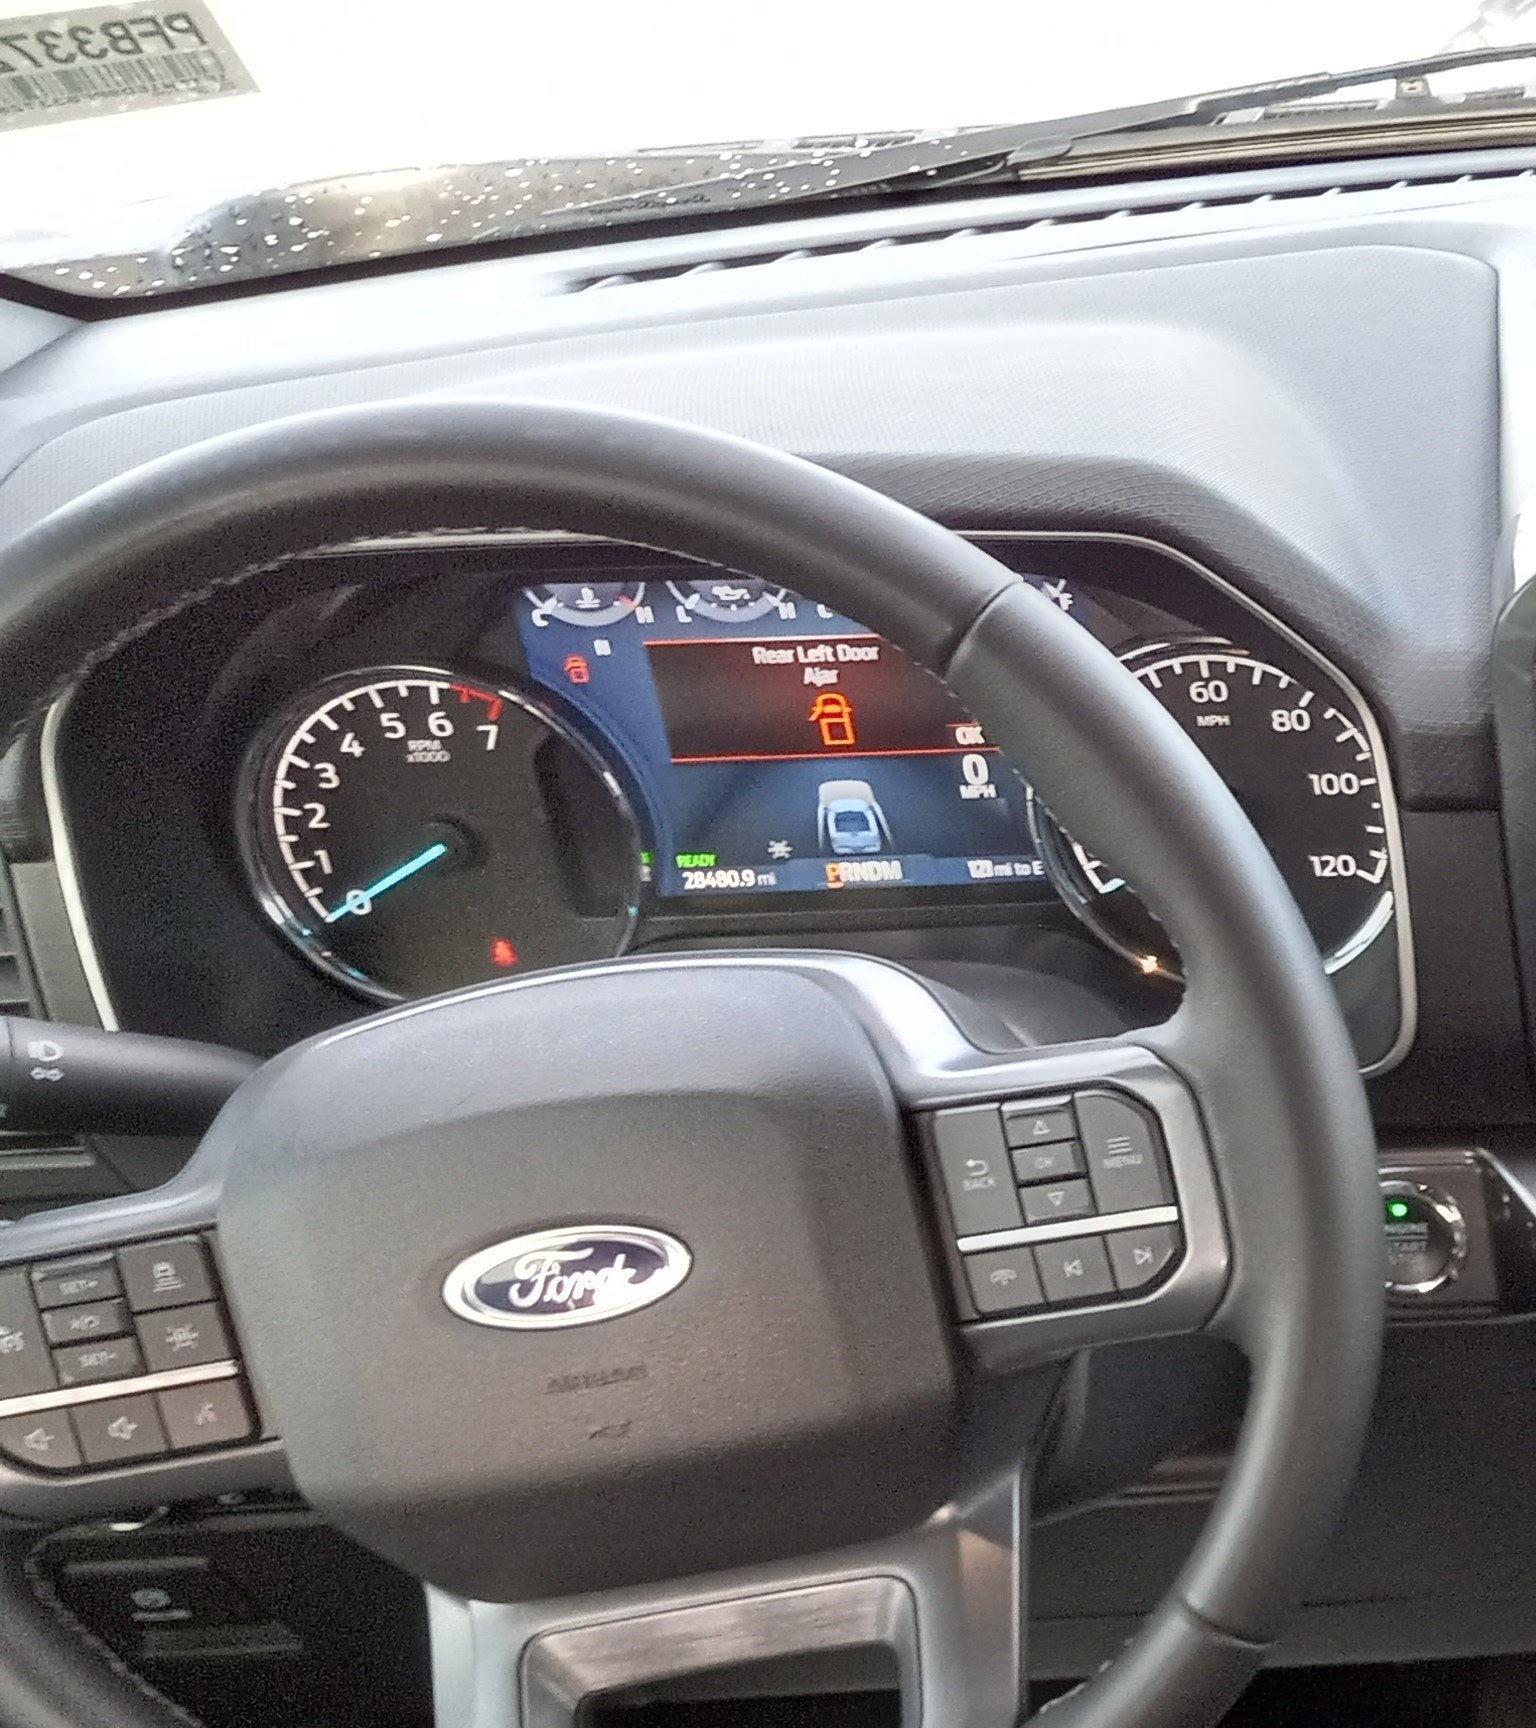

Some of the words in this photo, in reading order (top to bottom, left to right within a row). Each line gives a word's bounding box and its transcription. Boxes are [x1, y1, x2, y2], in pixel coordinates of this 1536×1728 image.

[636, 605, 655, 624] H
[779, 601, 797, 620] H
[753, 646, 795, 665] Rear
[799, 645, 834, 663] Left
[837, 644, 879, 662] Door
[803, 667, 838, 686] Ajar
[1189, 680, 1229, 704] 60
[380, 712, 407, 740] 5
[428, 711, 454, 738] 6
[1196, 714, 1231, 728] MPH
[1271, 708, 1312, 733] 80
[340, 732, 365, 758] 4
[407, 738, 443, 752] RPM
[476, 723, 499, 751] 7
[955, 726, 985, 745] OK
[406, 751, 451, 763] x1000
[315, 763, 342, 789] 3
[961, 753, 989, 785] 0
[958, 783, 997, 799] MPH
[1308, 773, 1361, 796] 100
[302, 803, 331, 829] 2
[314, 848, 334, 875] 1
[676, 853, 717, 868] READY
[1310, 855, 1357, 879] 120
[681, 869, 755, 890] 28480.9
[757, 872, 777, 887] mi
[346, 889, 373, 916] 0
[1103, 1153, 1144, 1169] MENU
[962, 1177, 996, 1192] BACK
